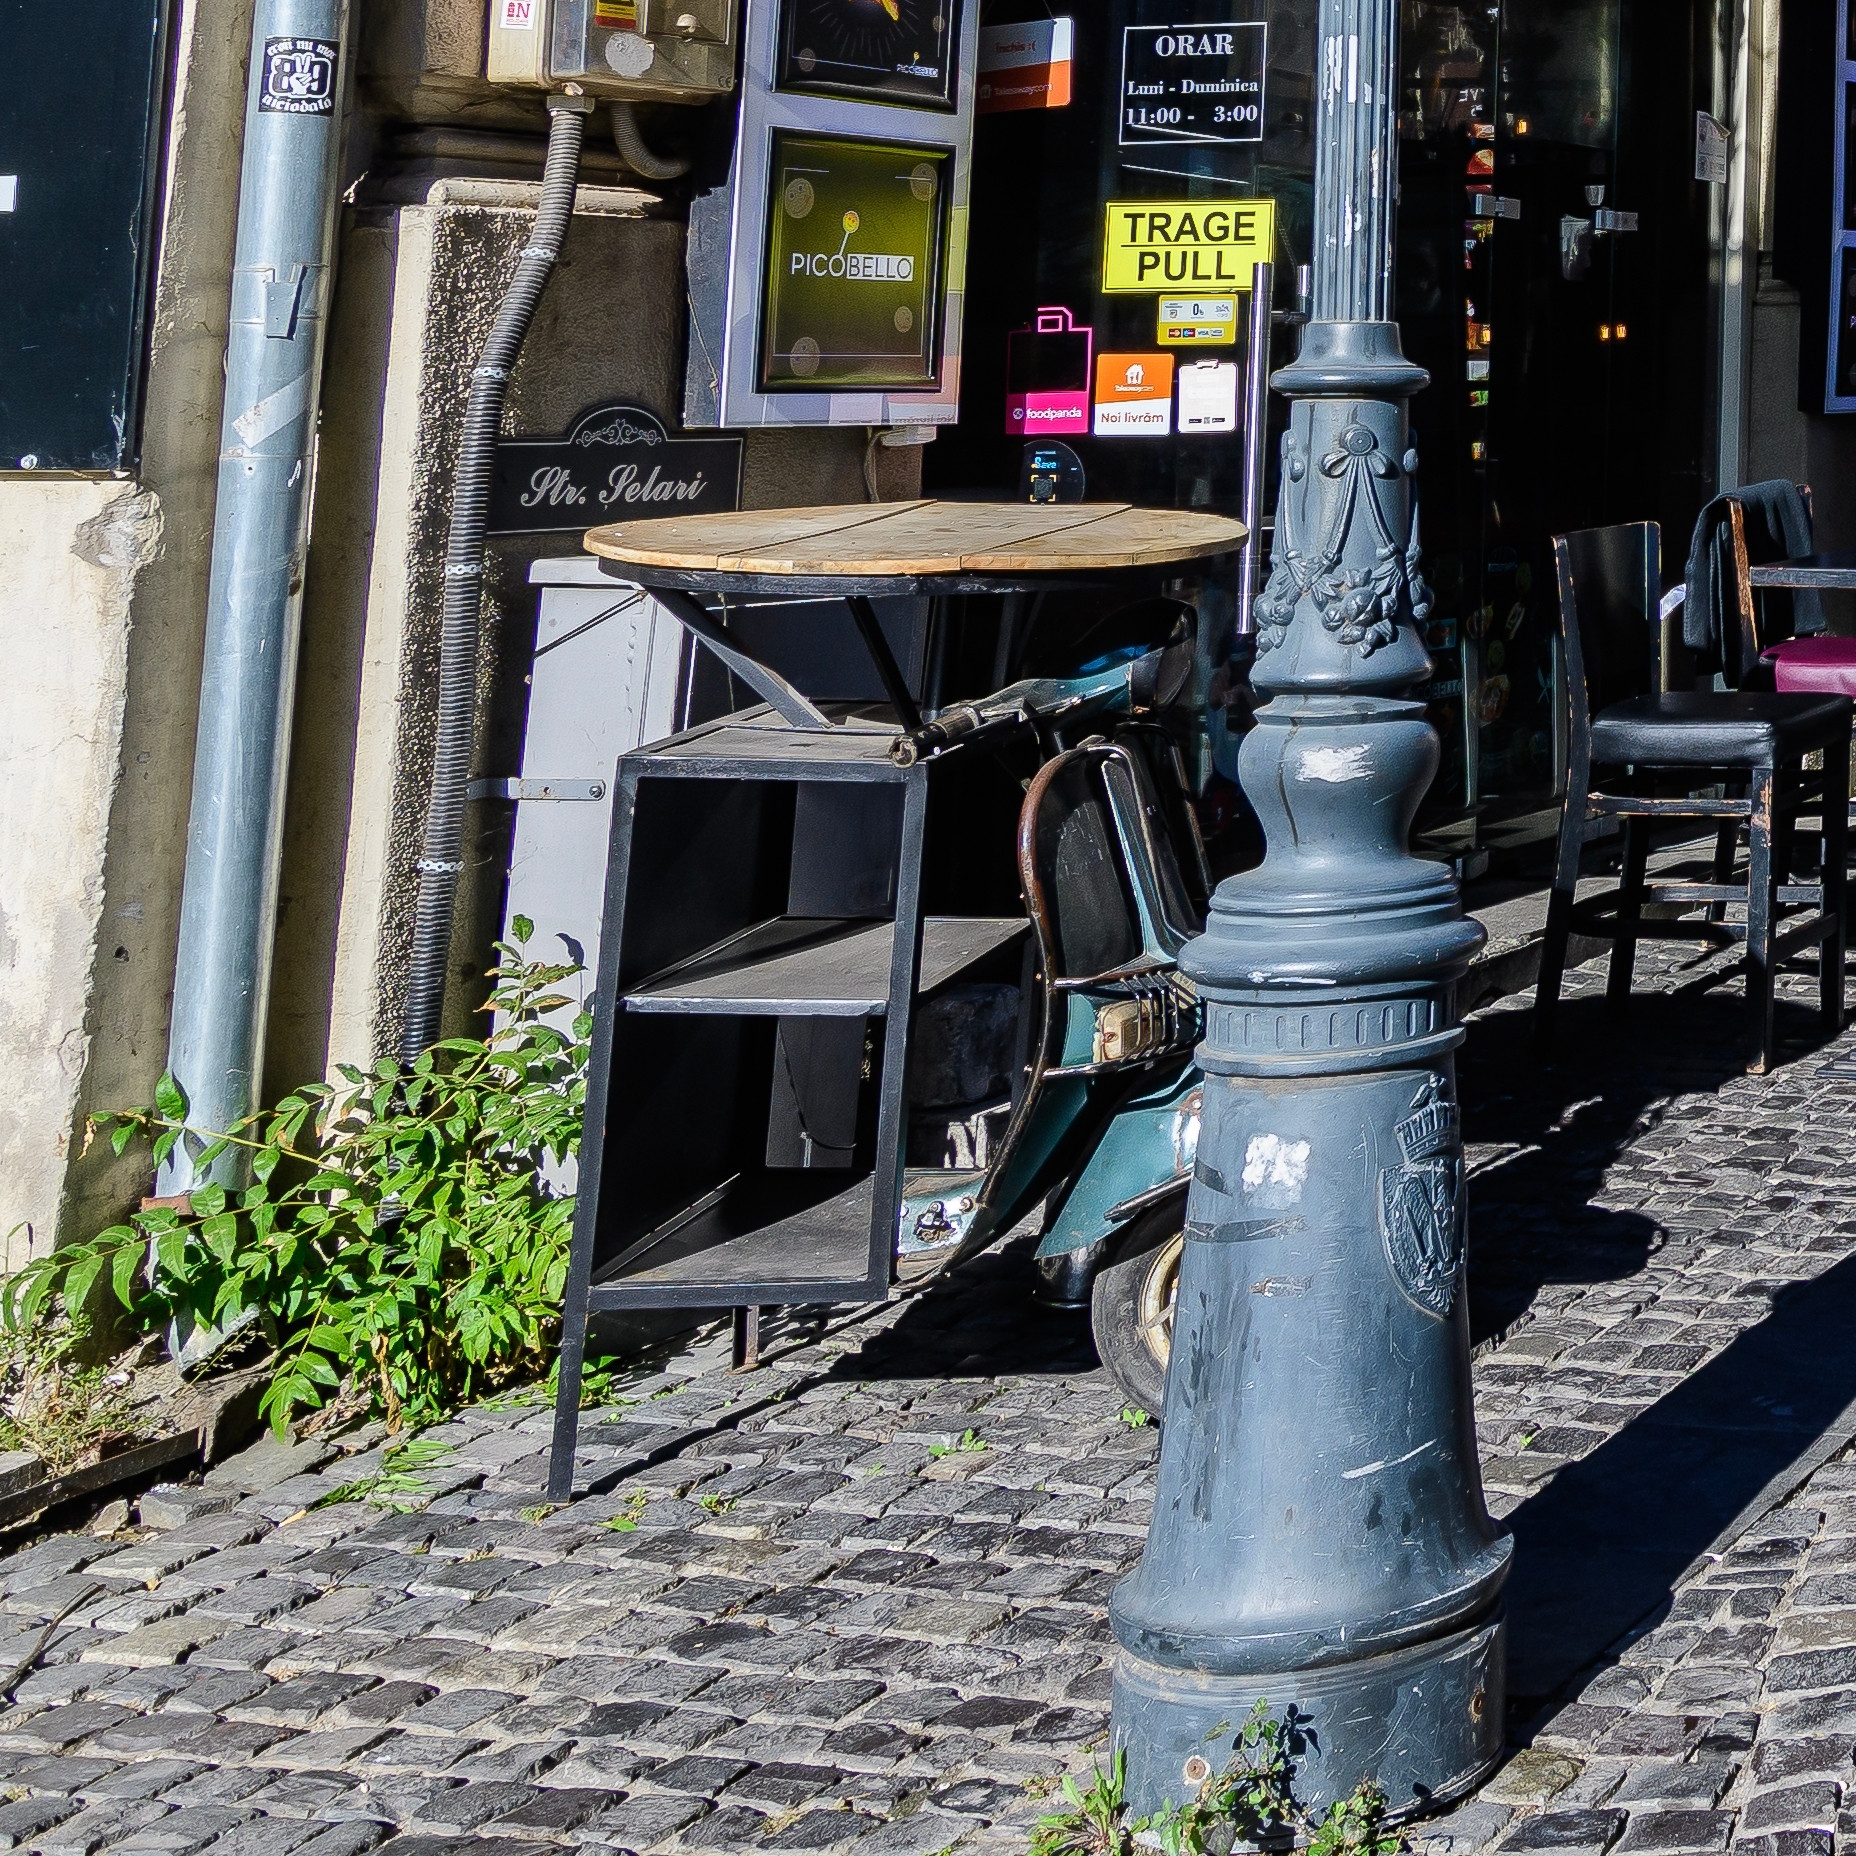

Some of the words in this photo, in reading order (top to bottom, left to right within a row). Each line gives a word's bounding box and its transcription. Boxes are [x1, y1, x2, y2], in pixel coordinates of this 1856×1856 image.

[1155, 33, 1235, 57] ORAR
[1127, 79, 1164, 96] Luni
[1125, 106, 1182, 126] 11:00
[1213, 104, 1259, 123] 3:00
[1123, 210, 1256, 244] TRAGE
[790, 252, 914, 280] PICOBELLO
[1137, 250, 1236, 282] PULL
[1026, 406, 1083, 421] foodpanda
[1101, 411, 1122, 423] Noi
[520, 466, 587, 507] Str.
